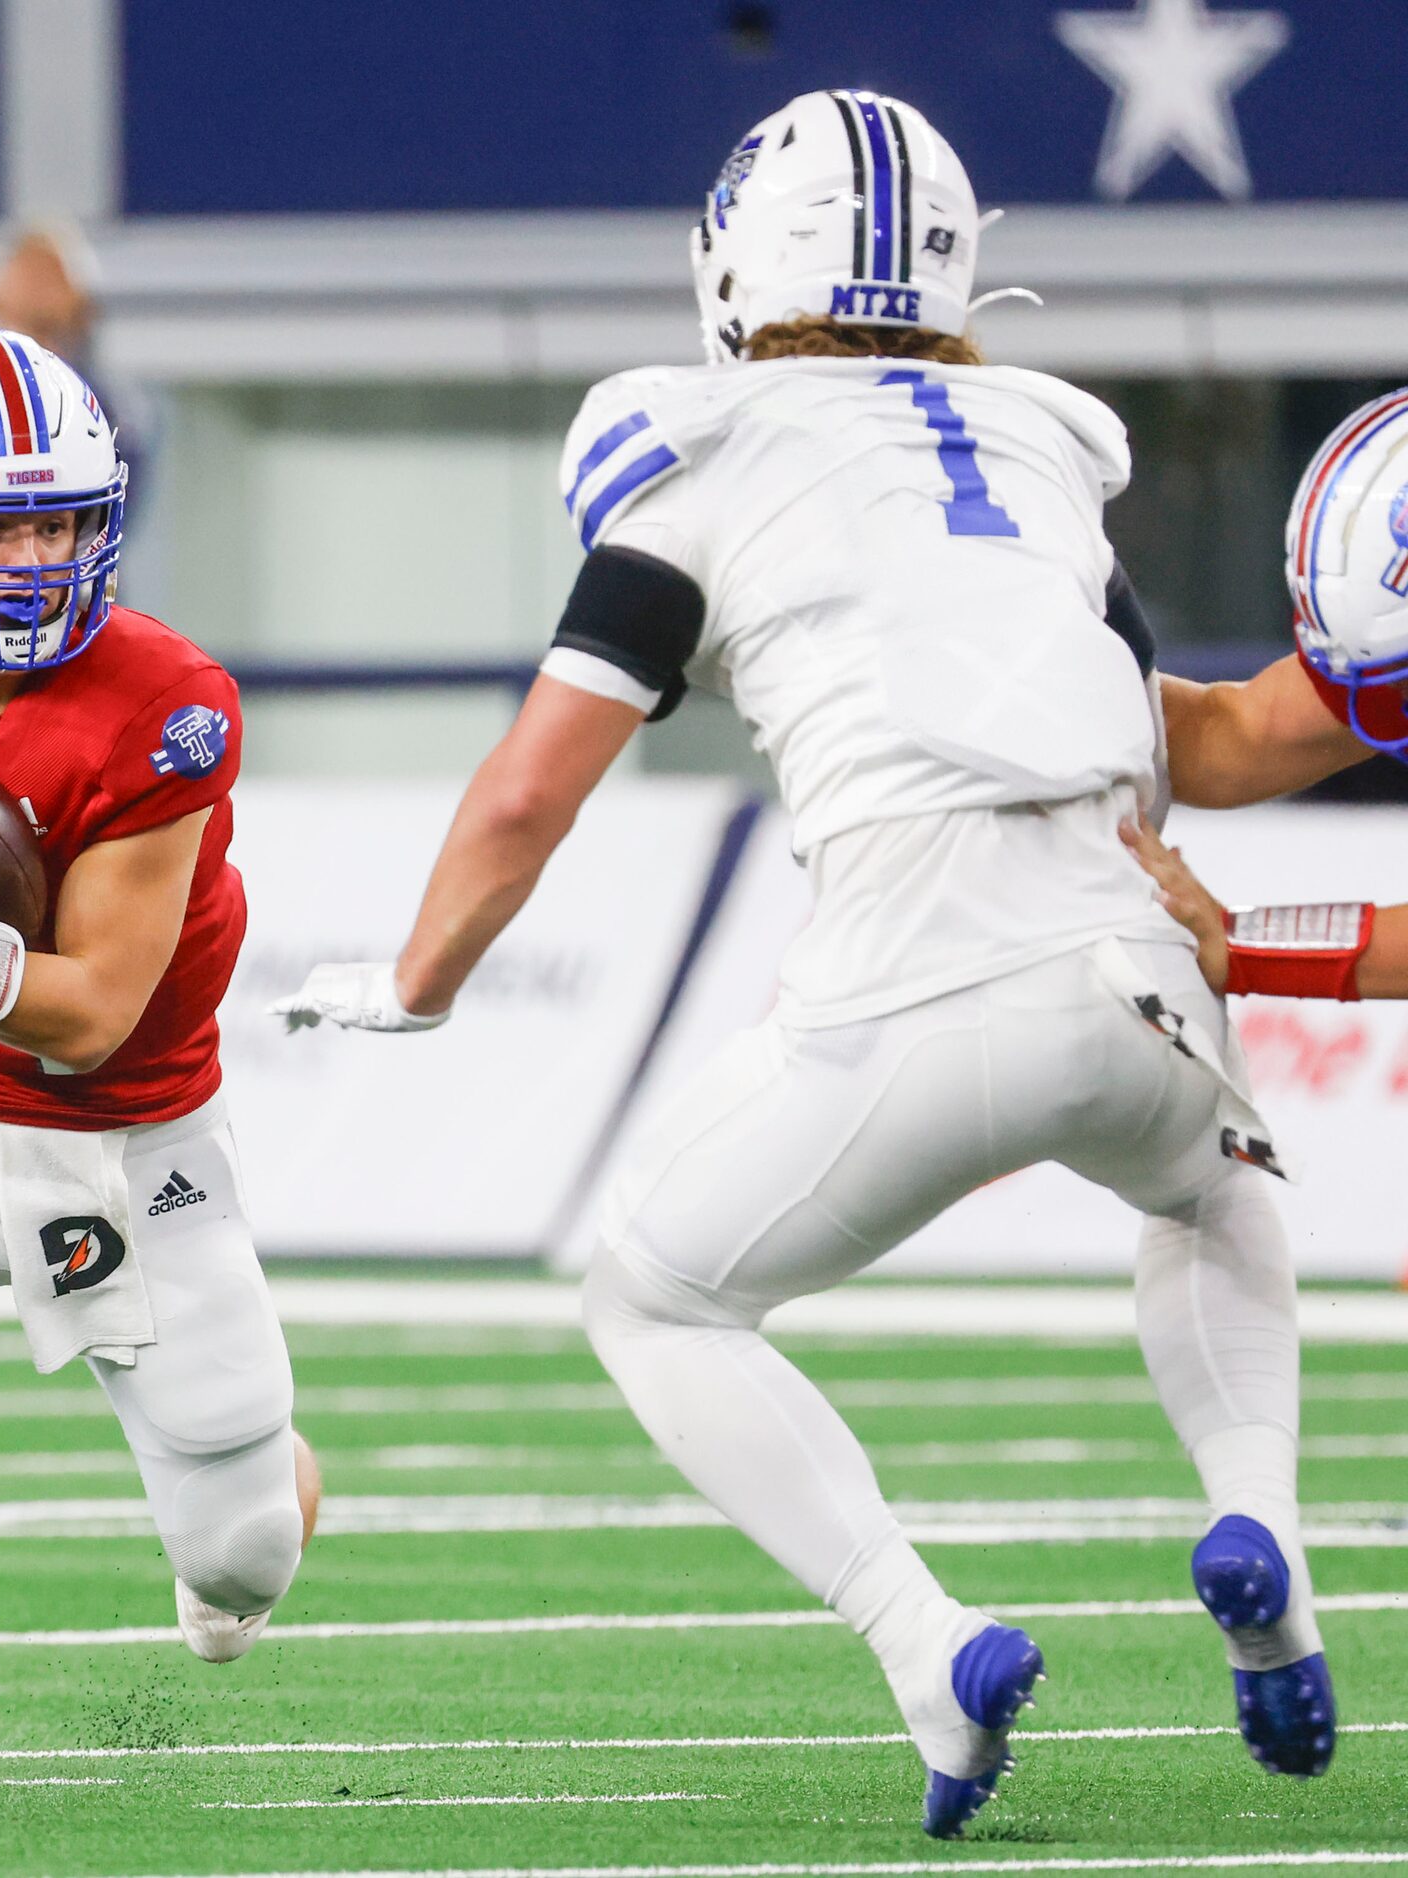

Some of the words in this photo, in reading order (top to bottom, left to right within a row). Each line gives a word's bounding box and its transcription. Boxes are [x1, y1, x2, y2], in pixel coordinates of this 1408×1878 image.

[830, 285, 922, 322] MTXE
[874, 370, 1021, 538] 1
[6, 468, 55, 486] TIGERS
[148, 1190, 207, 1216] adidas
